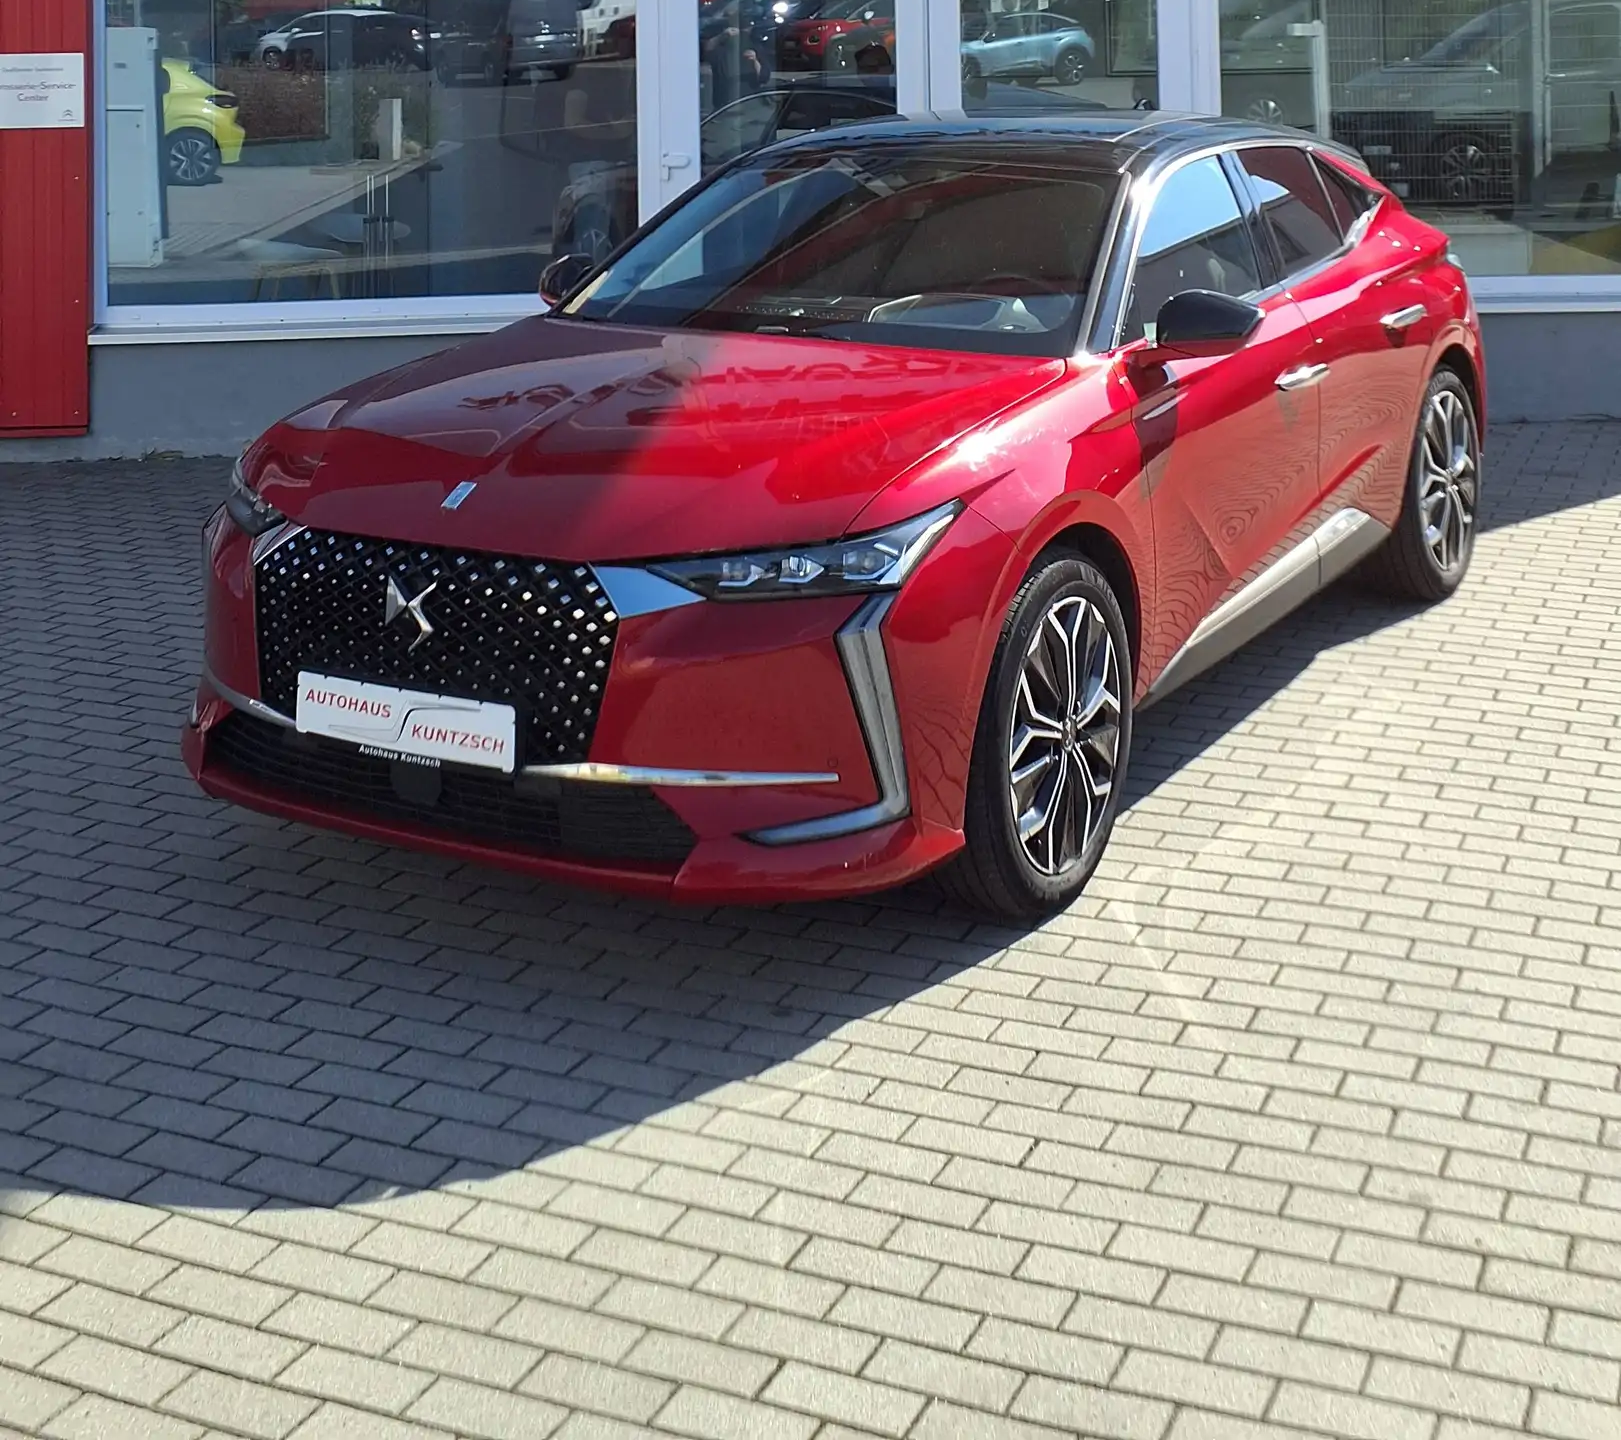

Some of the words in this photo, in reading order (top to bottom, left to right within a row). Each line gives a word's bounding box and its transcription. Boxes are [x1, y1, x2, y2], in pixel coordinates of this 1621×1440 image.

[305, 688, 392, 719] AUTOHAUS
[411, 723, 505, 754] KUNTZSCH
[358, 744, 399, 761] Autohaus
[400, 752, 441, 768] Kuntzsch
